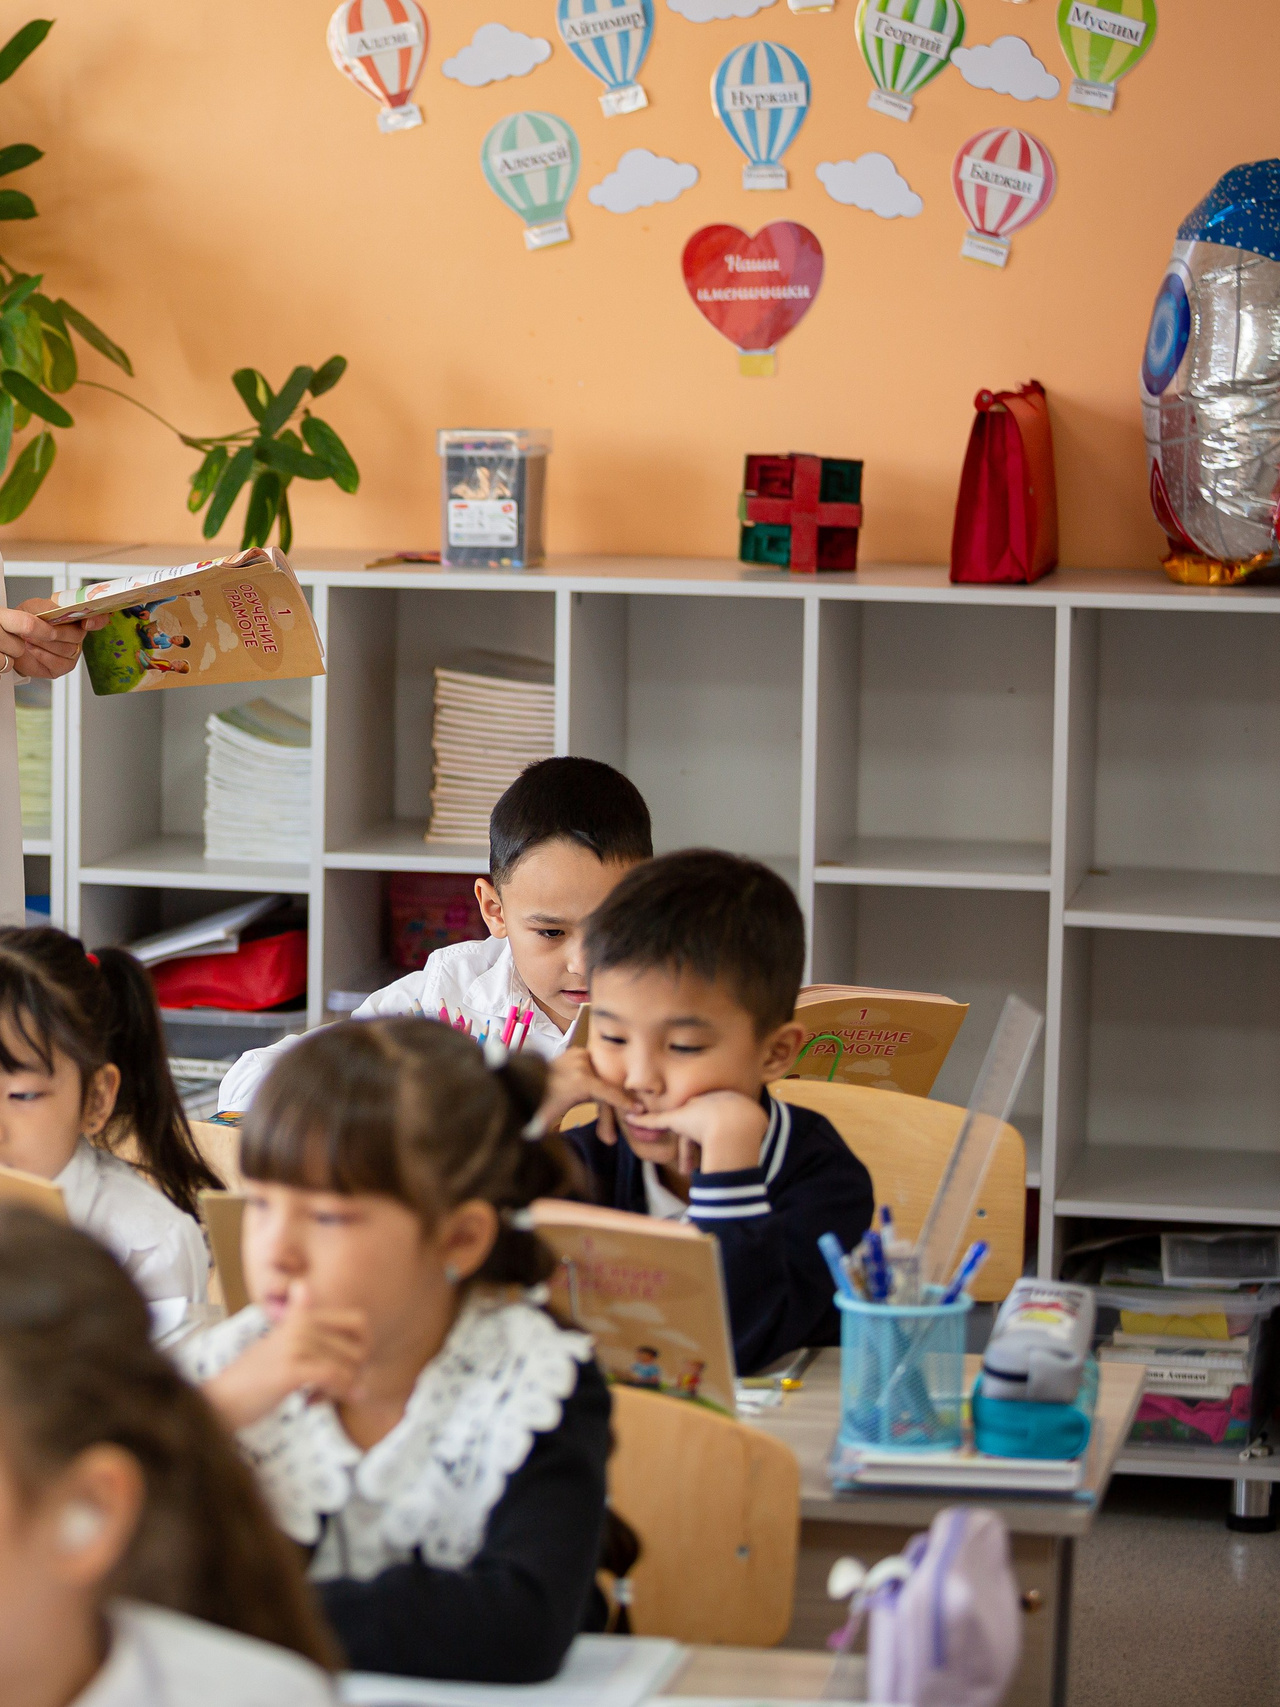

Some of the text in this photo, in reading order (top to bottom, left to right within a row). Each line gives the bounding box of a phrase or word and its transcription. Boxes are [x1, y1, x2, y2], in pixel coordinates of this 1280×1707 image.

[876, 17, 942, 54] Георгий
[1071, 6, 1140, 41] Муслим
[731, 91, 798, 110] Нуржан
[499, 145, 568, 172] Алексей
[724, 254, 780, 273] Наши
[697, 285, 811, 302] именинники
[223, 589, 259, 648] ГРАМОТЕ
[239, 584, 278, 653] ОБУЧЕНИЕ
[859, 1008, 869, 1021] 1
